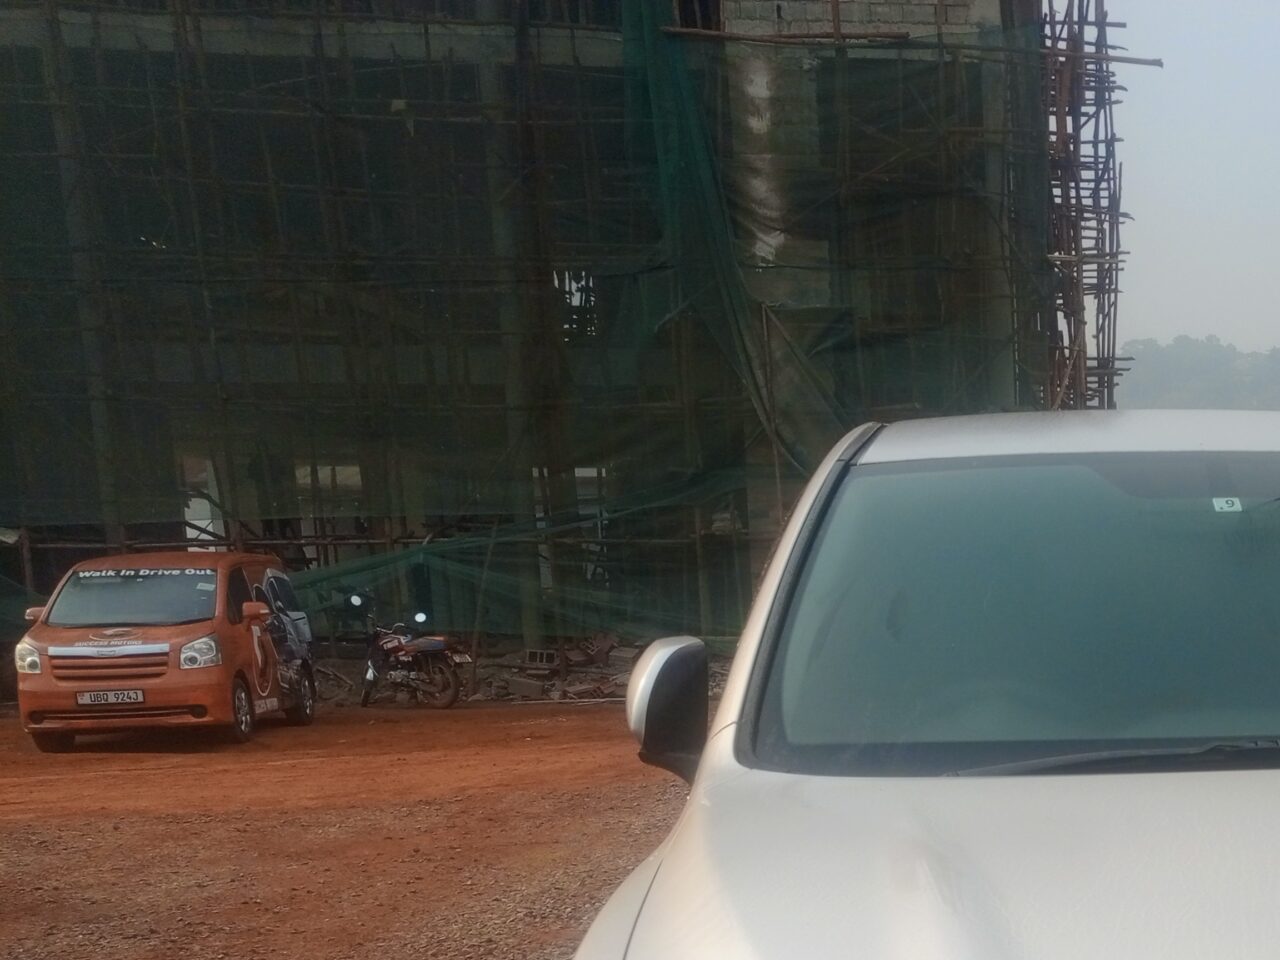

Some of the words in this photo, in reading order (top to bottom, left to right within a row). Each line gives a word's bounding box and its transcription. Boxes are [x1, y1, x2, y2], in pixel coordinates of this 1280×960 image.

[79, 569, 117, 578] Walk
[120, 569, 134, 577] In
[139, 568, 181, 576] Drive
[184, 568, 215, 576] Out
[89, 692, 109, 703] UBQ
[113, 691, 139, 702] 924J
